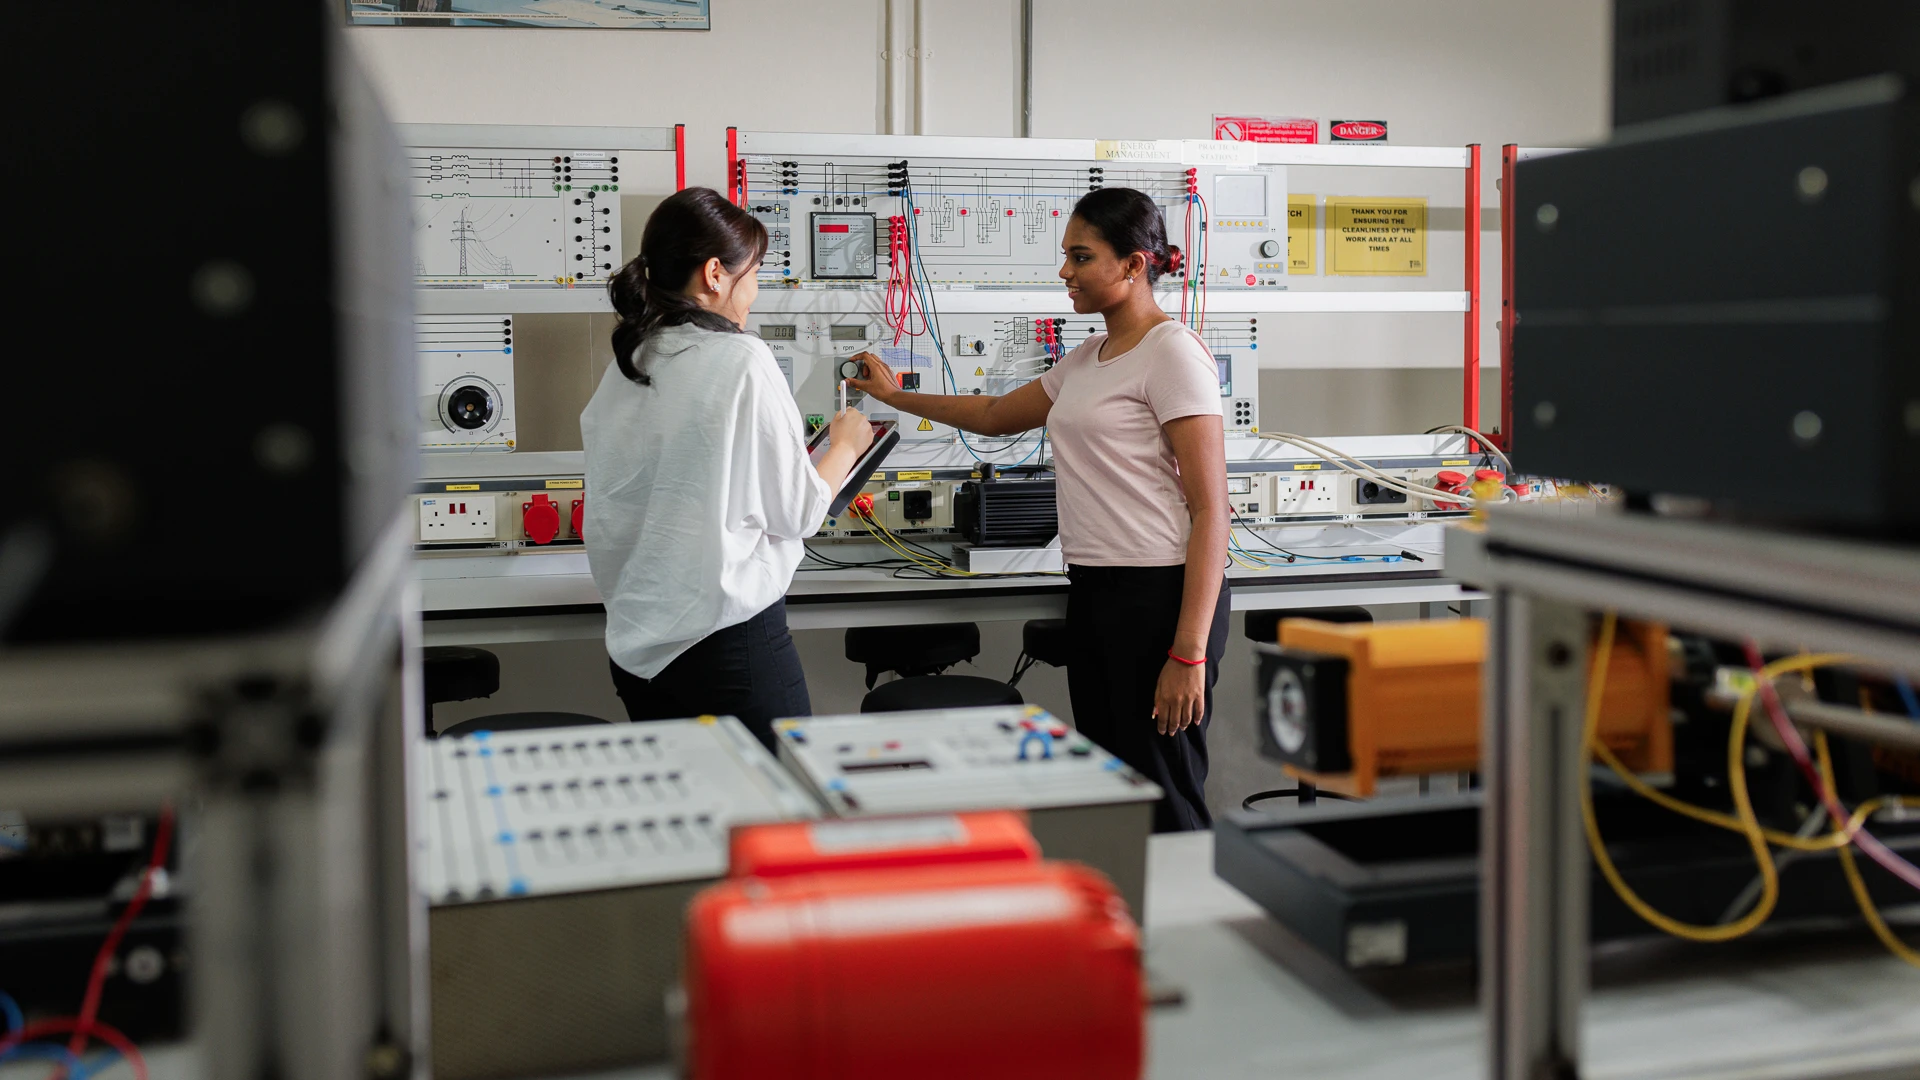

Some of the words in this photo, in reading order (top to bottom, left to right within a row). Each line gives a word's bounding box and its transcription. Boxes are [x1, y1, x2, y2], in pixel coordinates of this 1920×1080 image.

[1340, 126, 1377, 135] DANGER
[1120, 142, 1157, 150] ENERGY
[1106, 150, 1171, 159] MANAGEMENT
[774, 328, 794, 337] 0.00
[858, 328, 864, 338] 0
